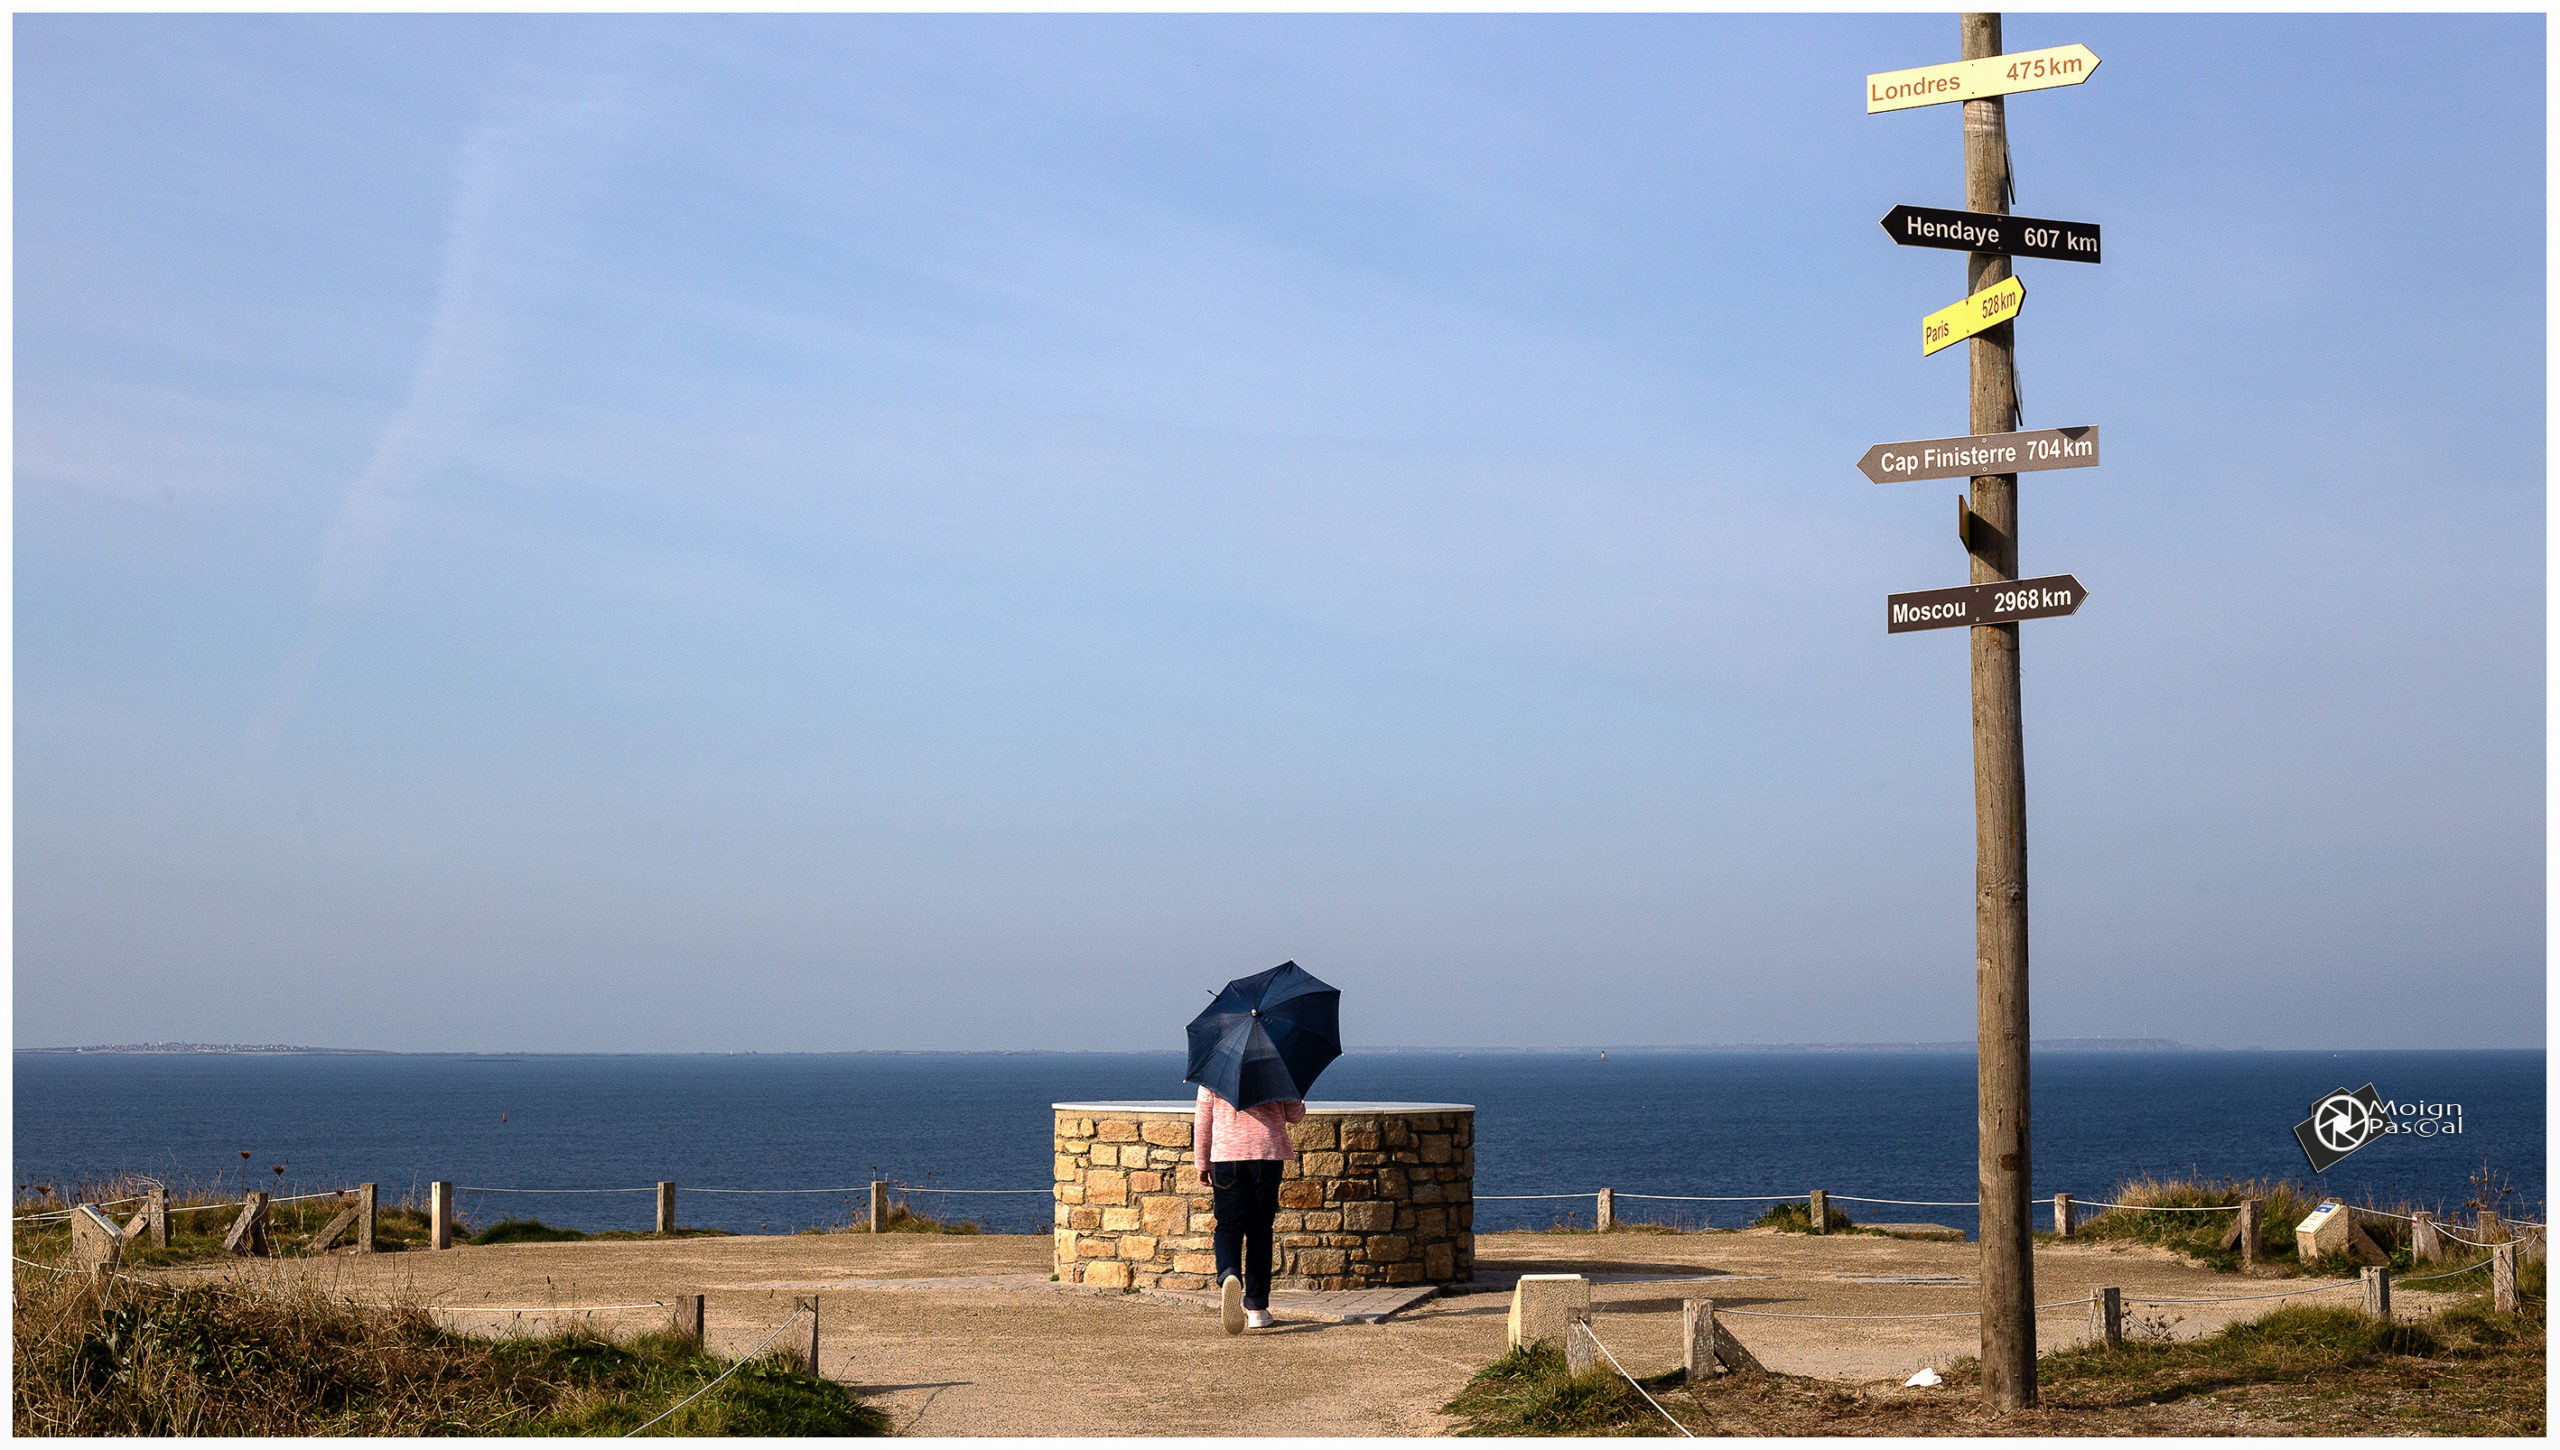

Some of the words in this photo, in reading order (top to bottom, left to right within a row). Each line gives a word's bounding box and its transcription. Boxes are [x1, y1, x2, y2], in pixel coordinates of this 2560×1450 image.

[1871, 75, 1961, 102] Londres
[2006, 59, 2045, 81] 475
[2050, 57, 2083, 76] km
[1907, 215, 2000, 246] Hendaye
[2024, 227, 2060, 248] 607
[2067, 231, 2098, 252] km
[1925, 320, 1949, 345] Paris
[1982, 294, 1999, 319] 528
[2001, 291, 2016, 311] km
[1880, 452, 1919, 475] Cap
[1924, 445, 2017, 469] Finisterre
[2026, 438, 2061, 461] 704
[2064, 438, 2093, 457] km
[1893, 601, 1967, 624] Moscou
[1994, 588, 2039, 613] 2968
[2042, 587, 2072, 608] km
